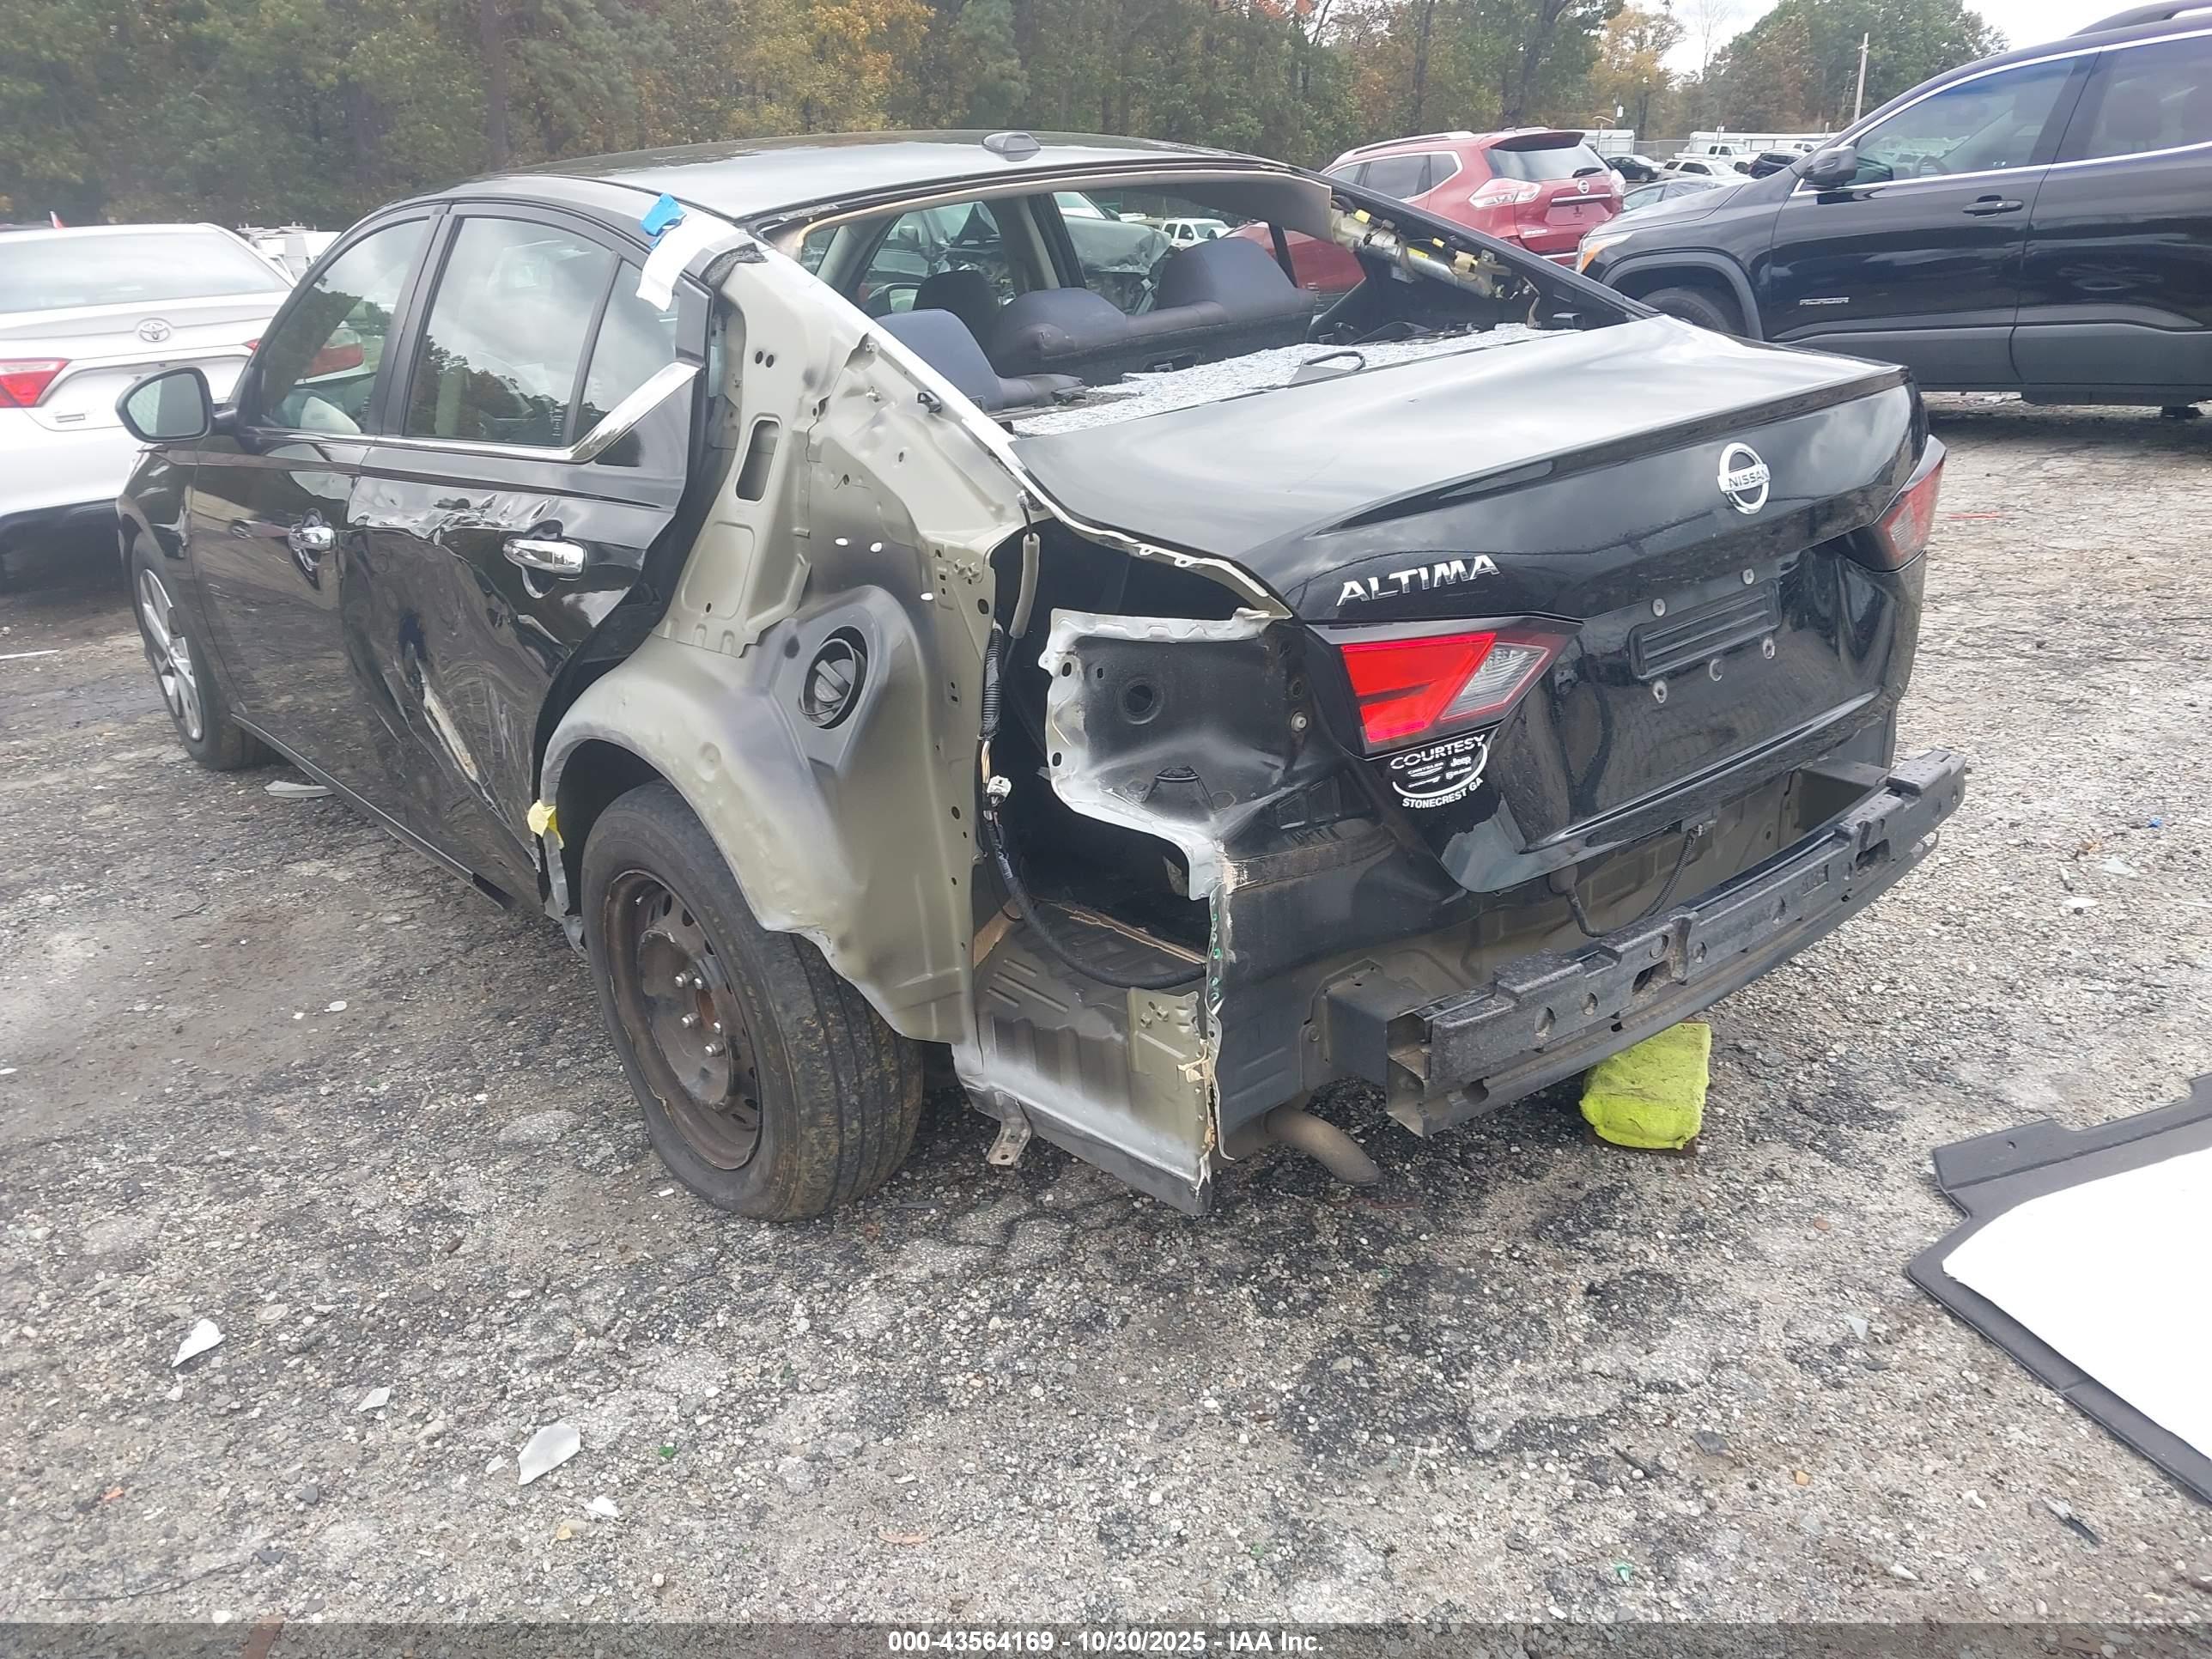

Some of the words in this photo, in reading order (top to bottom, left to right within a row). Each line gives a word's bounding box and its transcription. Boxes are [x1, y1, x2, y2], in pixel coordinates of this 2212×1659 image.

[1728, 469, 1770, 489] NISSAN
[1335, 554, 1501, 606] ALTIMA
[1390, 734, 1486, 769] COURTESY
[1401, 787, 1468, 808] STONECREST
[1468, 777, 1484, 792] GA
